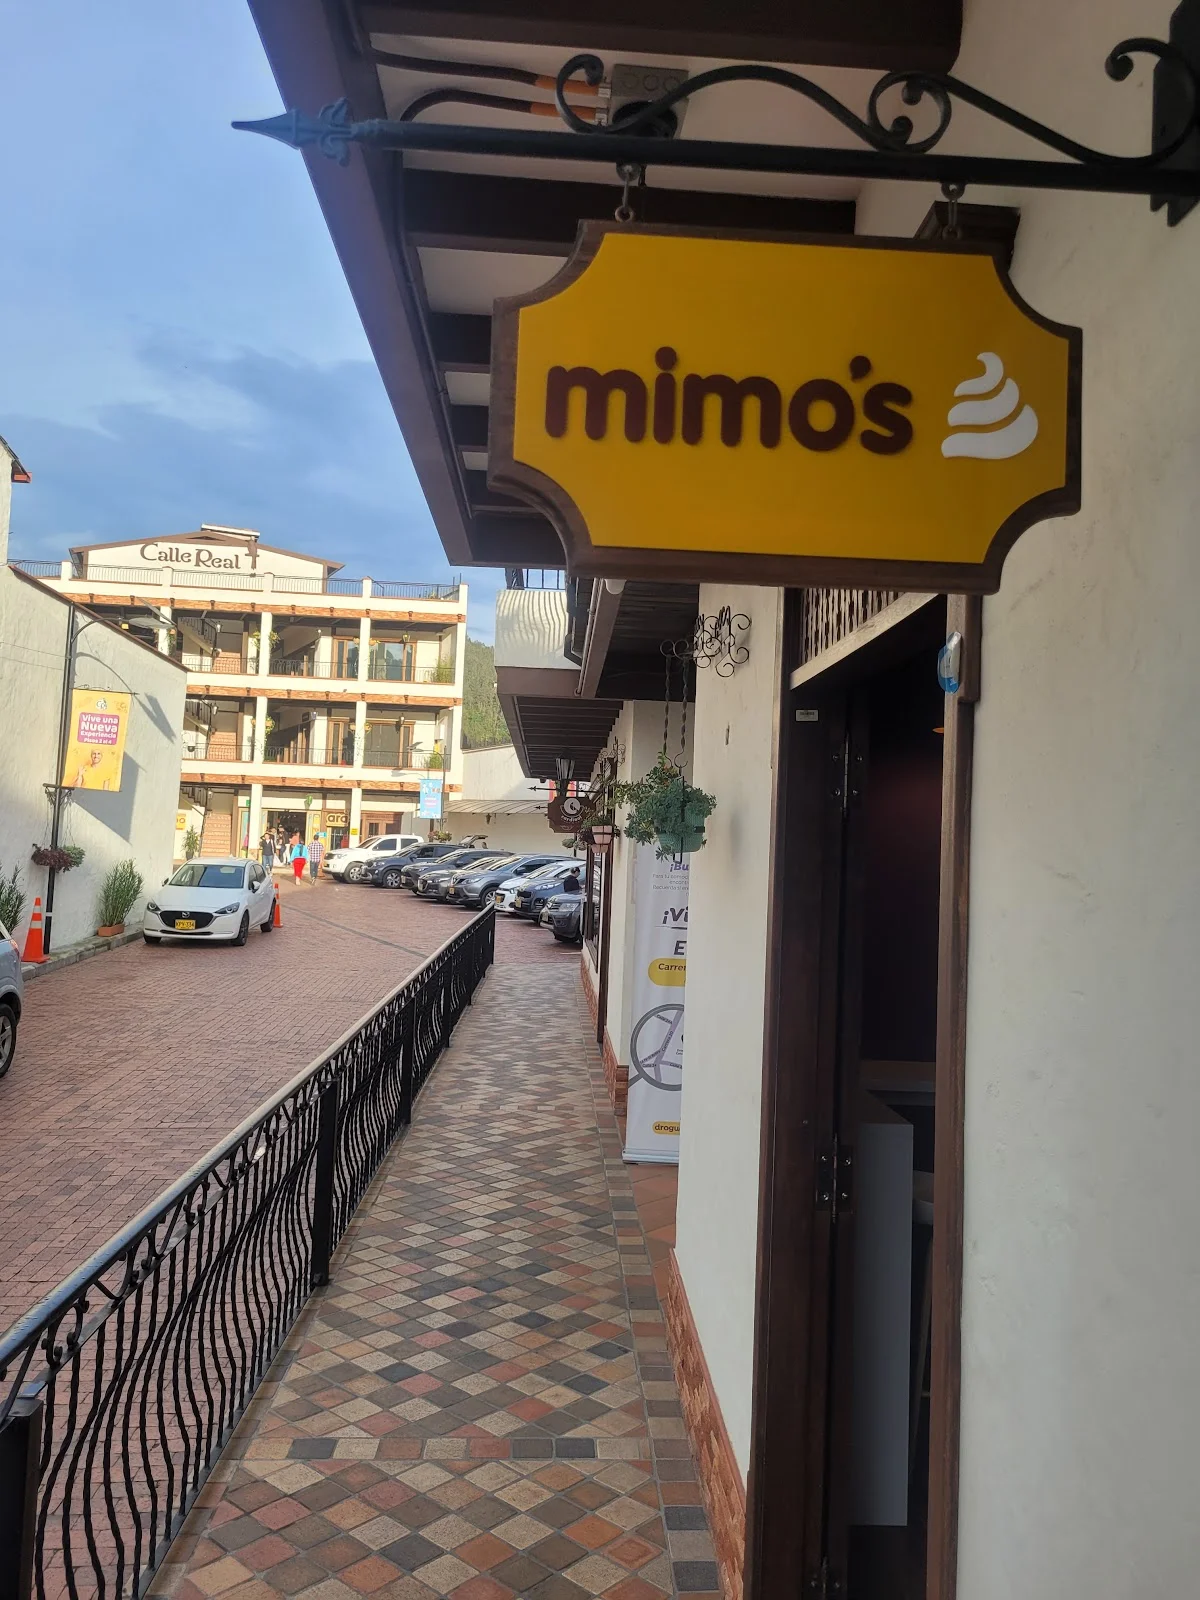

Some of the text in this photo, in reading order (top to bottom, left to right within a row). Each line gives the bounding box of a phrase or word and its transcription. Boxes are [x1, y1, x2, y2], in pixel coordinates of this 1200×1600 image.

[544, 345, 914, 456] mimo's
[140, 542, 241, 569] Calle Real
[82, 714, 101, 722] Vive
[81, 721, 118, 733] Nueva
[80, 730, 116, 739] Experiencia
[327, 814, 349, 824] ara
